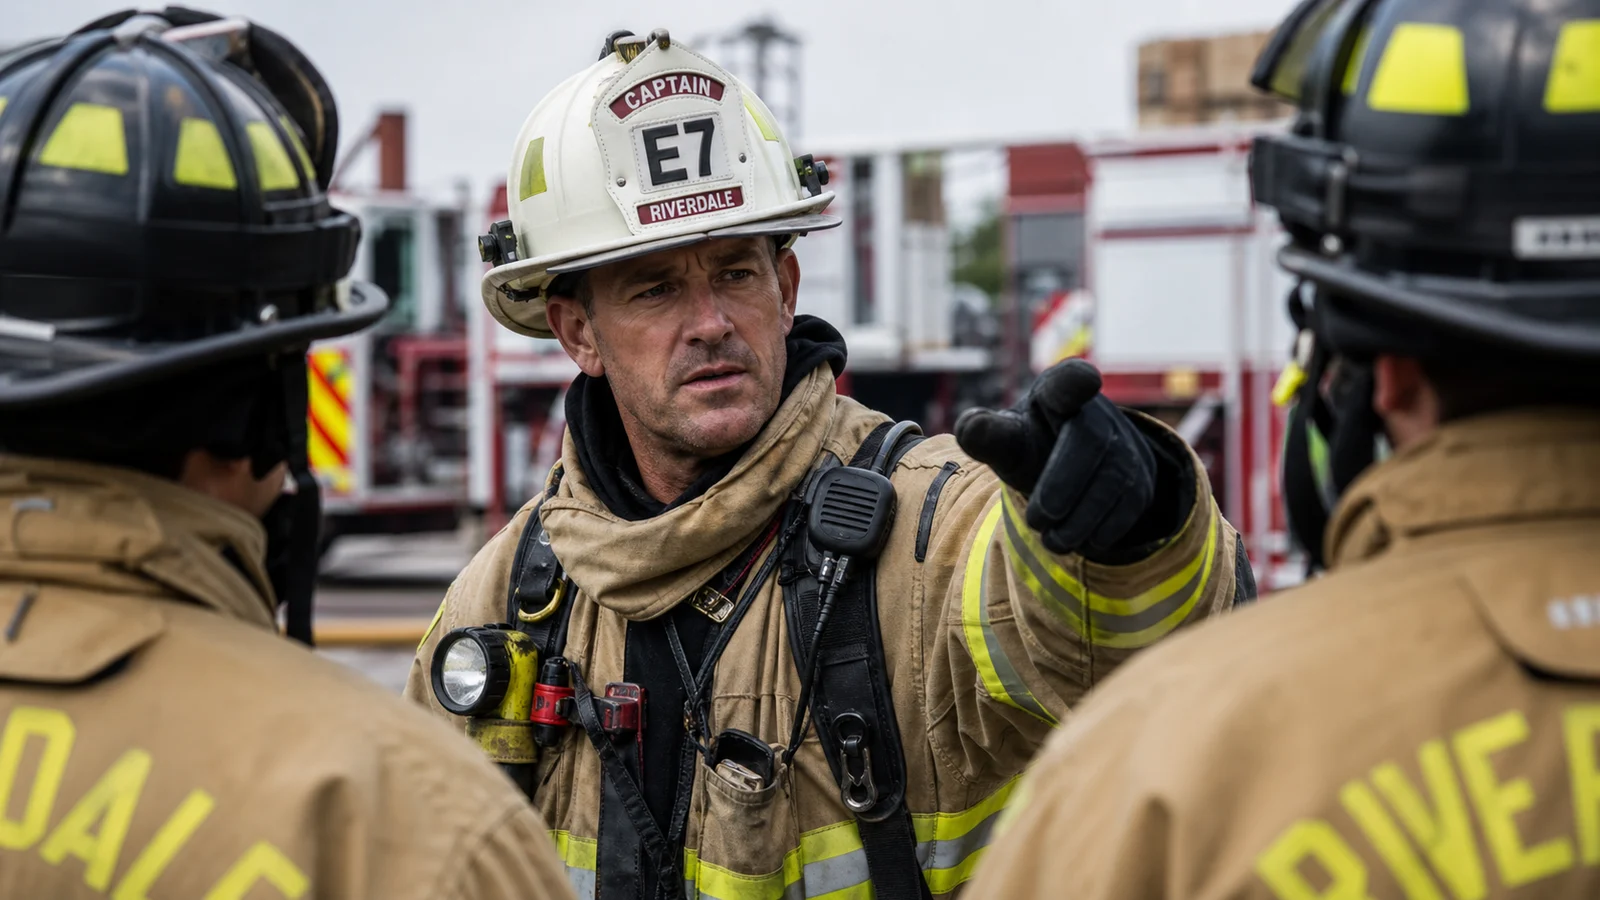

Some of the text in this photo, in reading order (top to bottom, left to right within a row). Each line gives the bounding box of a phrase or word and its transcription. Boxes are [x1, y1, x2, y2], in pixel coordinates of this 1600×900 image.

[624, 75, 711, 110] CAPTAIN
[642, 117, 715, 186] E7
[650, 190, 735, 222] RIVERDALE
